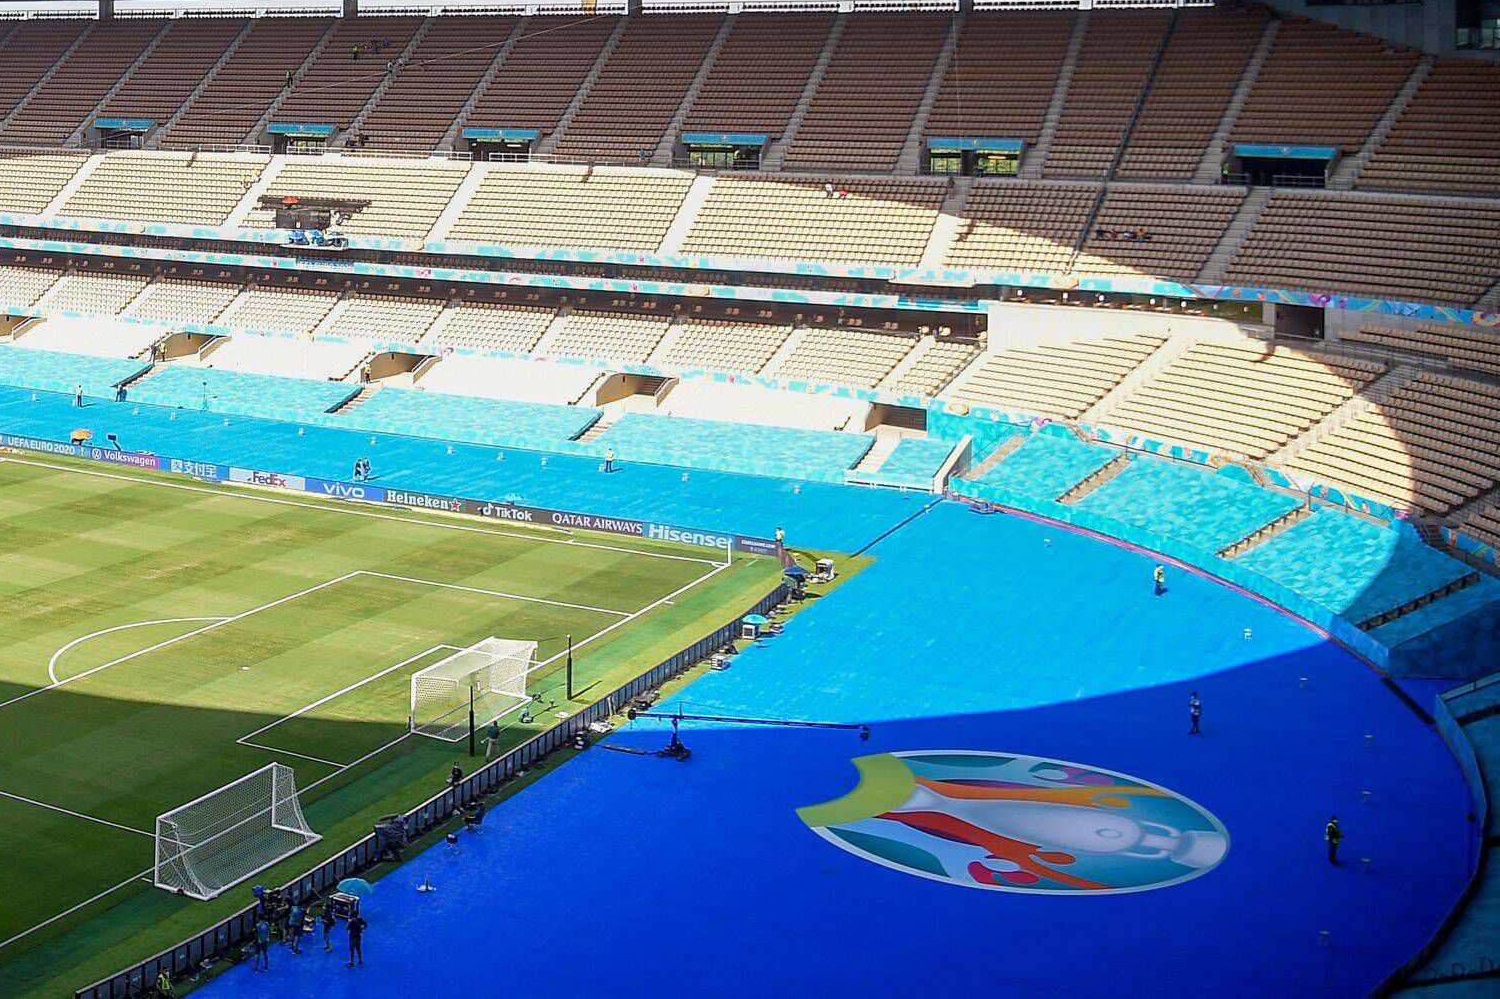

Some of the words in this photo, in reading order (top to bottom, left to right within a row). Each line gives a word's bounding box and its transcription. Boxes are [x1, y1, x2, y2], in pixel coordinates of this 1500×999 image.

[7, 436, 30, 449] UEFA
[31, 440, 53, 453] EURO
[53, 443, 76, 455] 2020
[104, 450, 156, 467] Volkswagen
[252, 471, 286, 487] FedEx
[322, 482, 365, 498] vivo
[386, 489, 449, 510] Heineken
[495, 505, 533, 522] TikTok
[552, 512, 591, 528] QATAR
[593, 518, 643, 535] AIRWAYS
[648, 523, 728, 549] Hisense
